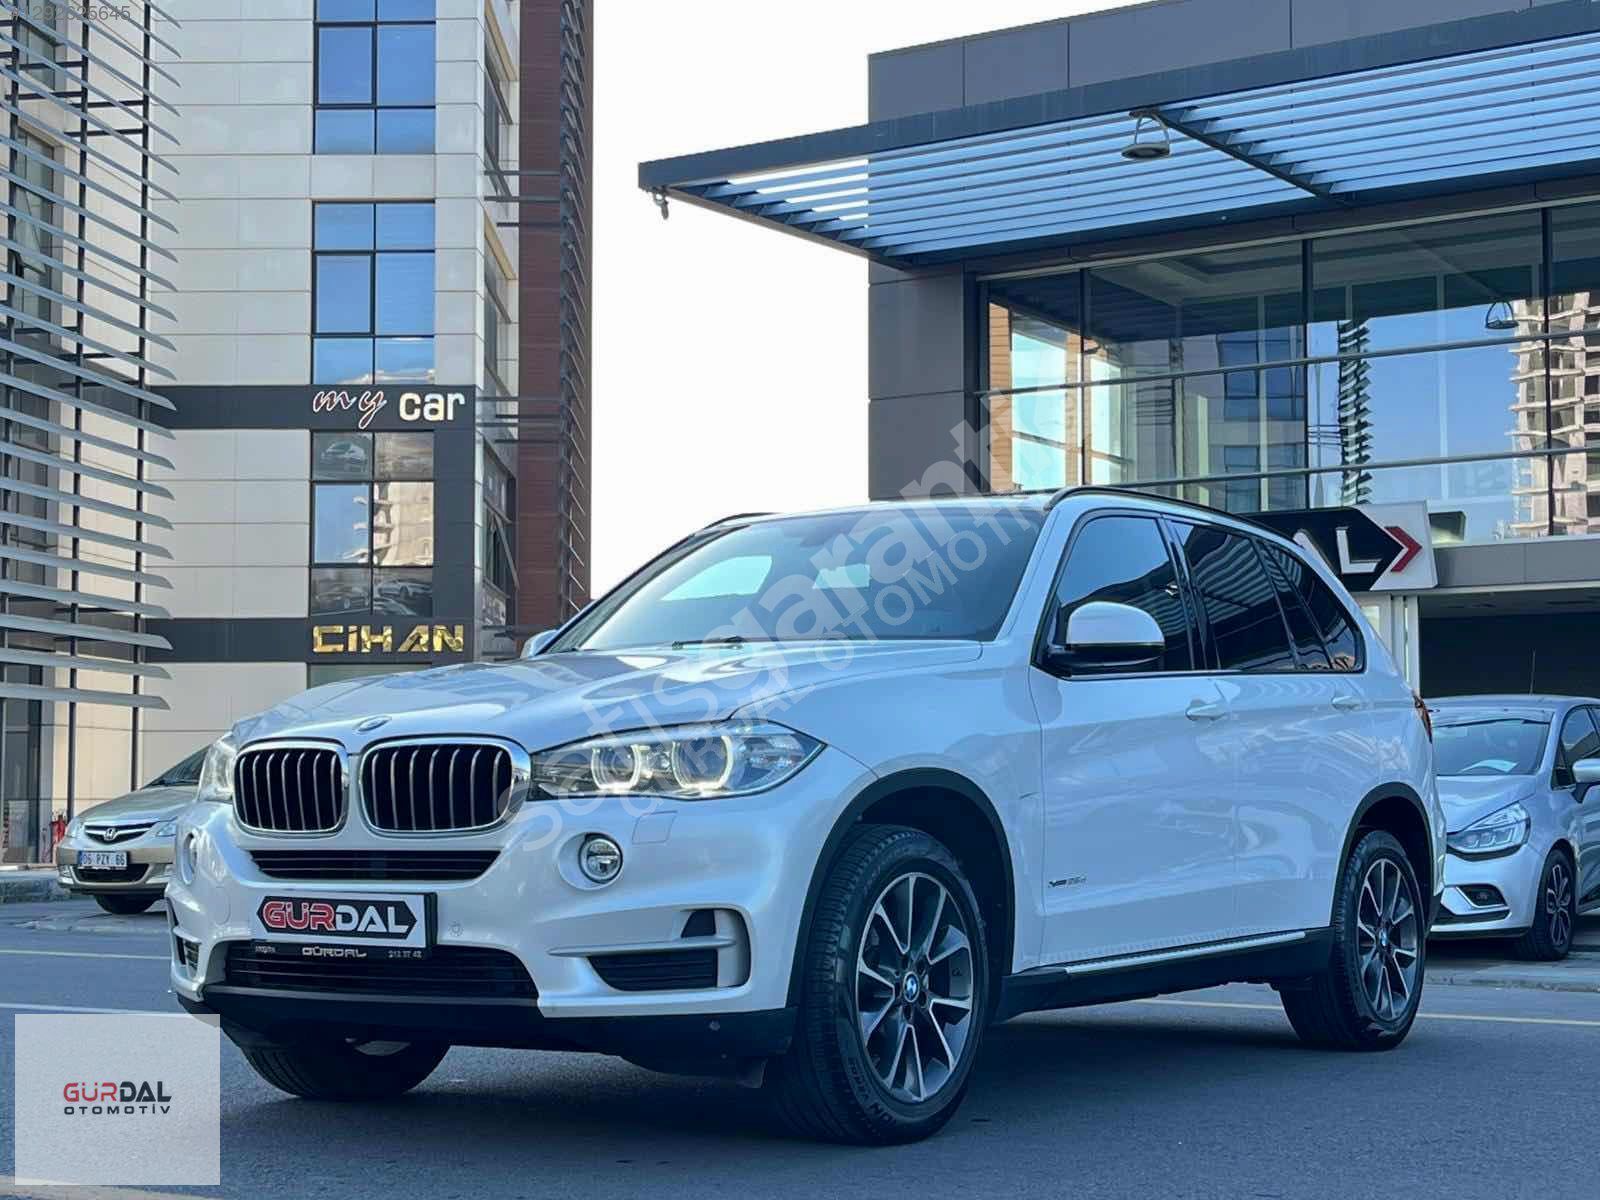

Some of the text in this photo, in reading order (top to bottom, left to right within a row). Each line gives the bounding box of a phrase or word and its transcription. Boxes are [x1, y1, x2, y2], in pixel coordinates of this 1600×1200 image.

[312, 390, 465, 430] my car
[262, 900, 410, 934] GÜRDAL
